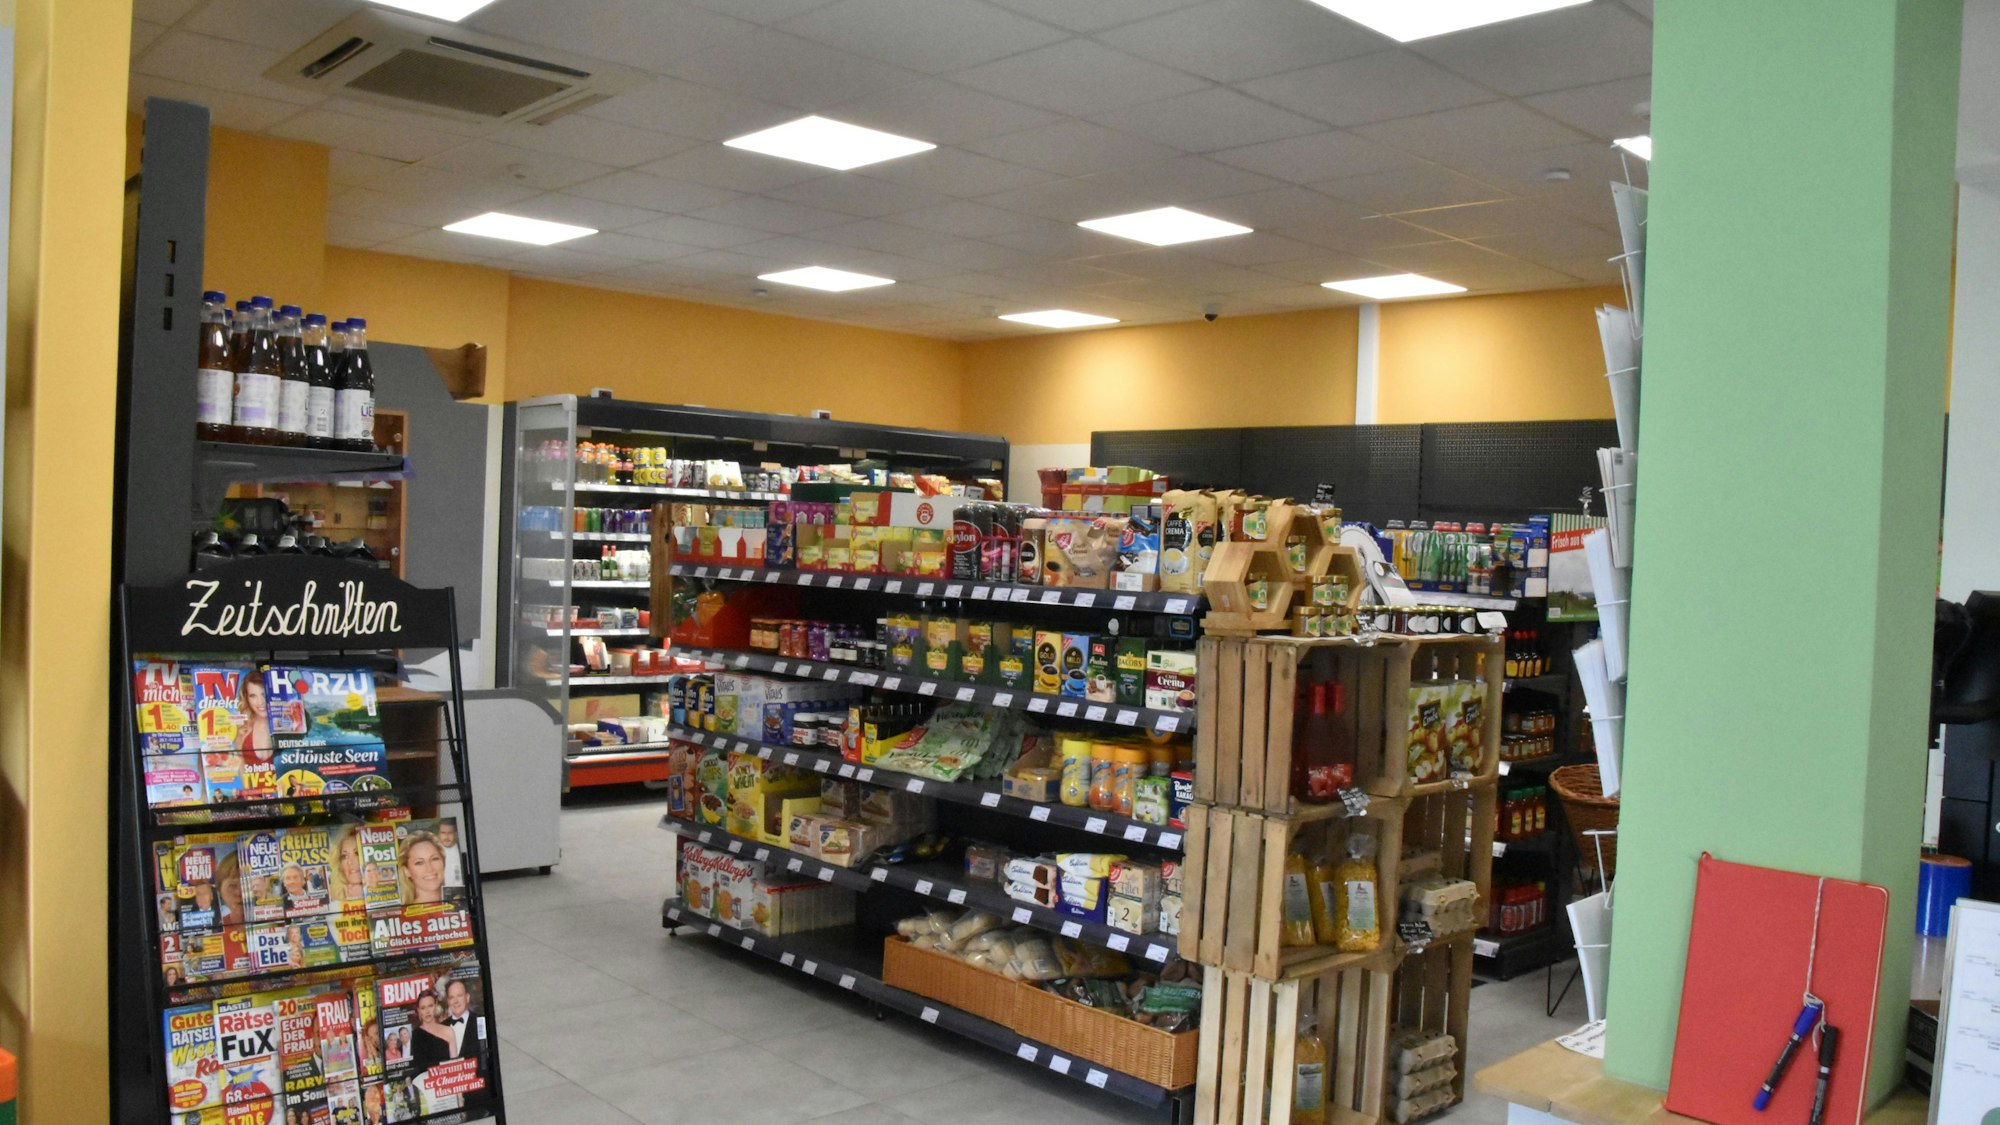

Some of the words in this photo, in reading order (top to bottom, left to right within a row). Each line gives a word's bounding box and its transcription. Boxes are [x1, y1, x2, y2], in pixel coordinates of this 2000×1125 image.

[198, 694, 239, 709] direkt
[280, 748, 343, 765] schönste
[344, 748, 379, 764] Seen
[280, 831, 328, 850] FREIZEIT
[360, 827, 394, 844] Neue
[250, 842, 277, 856] NEUE
[281, 847, 330, 866] SPASS
[362, 845, 397, 862] Post
[184, 855, 211, 866] NEUE
[186, 863, 213, 881] FRAU
[1121, 907, 1130, 922] 2
[374, 917, 423, 939] Alles
[427, 910, 468, 932] aus!
[258, 935, 279, 947] Das
[375, 940, 388, 949] Ihr
[390, 936, 411, 947] Glück
[412, 935, 423, 944] ist
[424, 930, 469, 943] zerbrochen
[260, 948, 288, 965] Ehe
[383, 977, 430, 1005] BUNTE
[278, 998, 297, 1017] 20
[317, 999, 350, 1028] FRAU
[171, 1013, 213, 1030] Gute
[282, 1016, 312, 1031] ECHO
[172, 1026, 215, 1046] RÄTSEL
[283, 1028, 306, 1043] DER
[220, 1028, 275, 1061] FuX
[283, 1038, 314, 1054] FRAU
[428, 1064, 463, 1077] Warum
[463, 1060, 476, 1070] tut
[436, 1087, 452, 1097] das
[453, 1083, 469, 1094] nur
[469, 1077, 485, 1090] an?
[225, 1089, 243, 1103] 68
[286, 1093, 301, 1106] im
